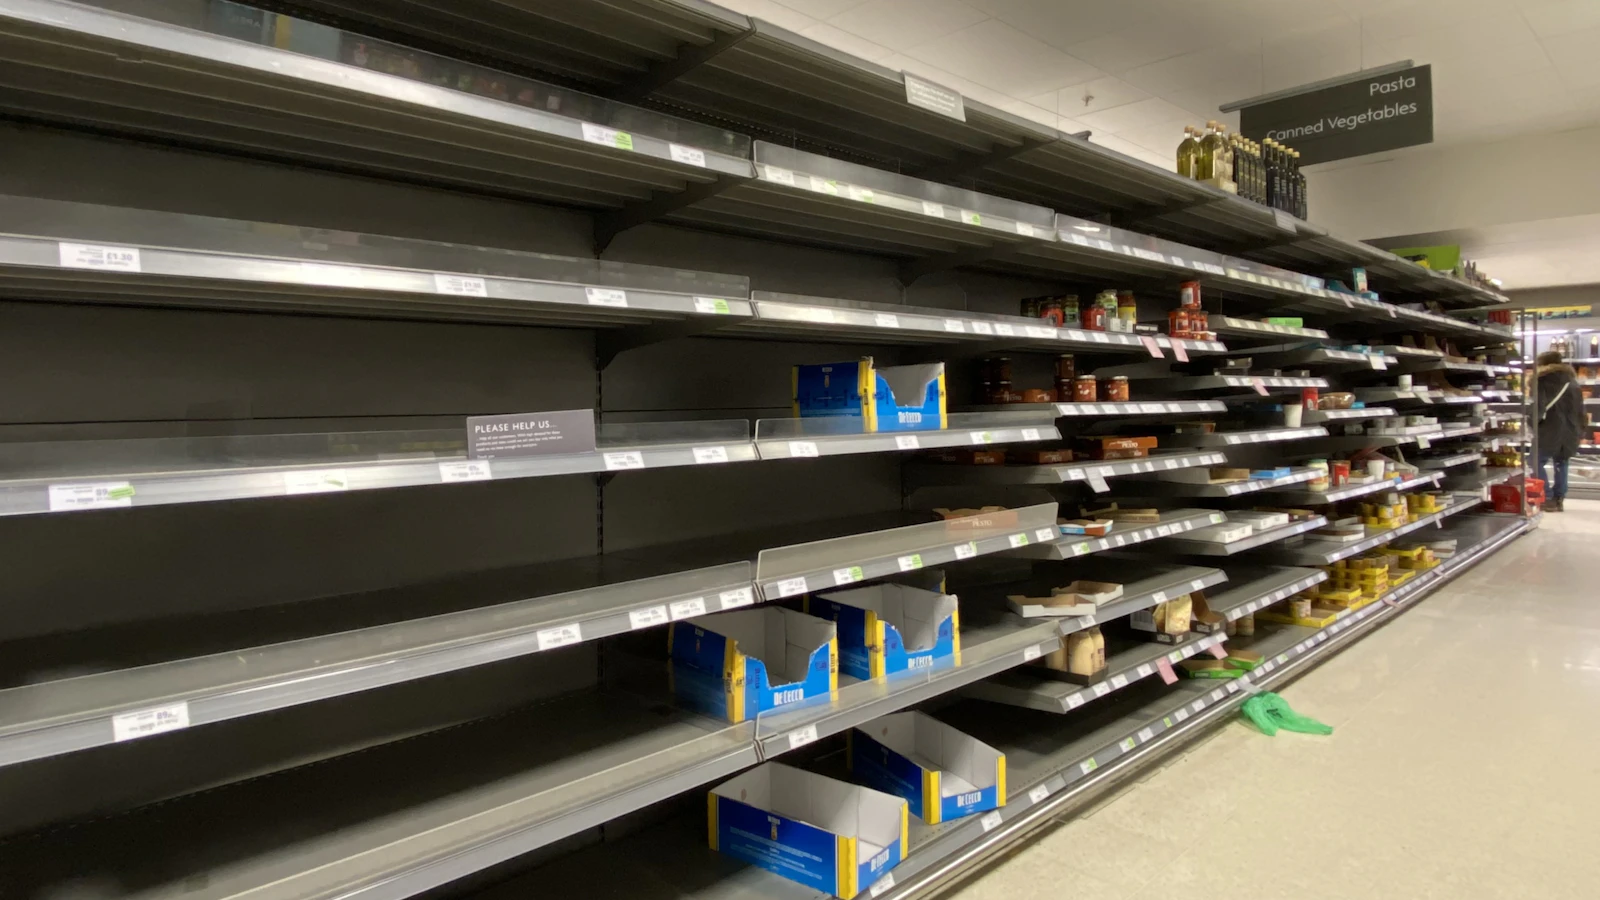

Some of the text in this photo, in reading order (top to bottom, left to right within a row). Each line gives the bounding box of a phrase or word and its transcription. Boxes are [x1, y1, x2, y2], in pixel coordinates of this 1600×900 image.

[1369, 75, 1416, 96] Pasta
[1266, 101, 1417, 142] Canned Vegetables
[475, 423, 509, 433] PLEASE
[512, 421, 535, 430] HELP
